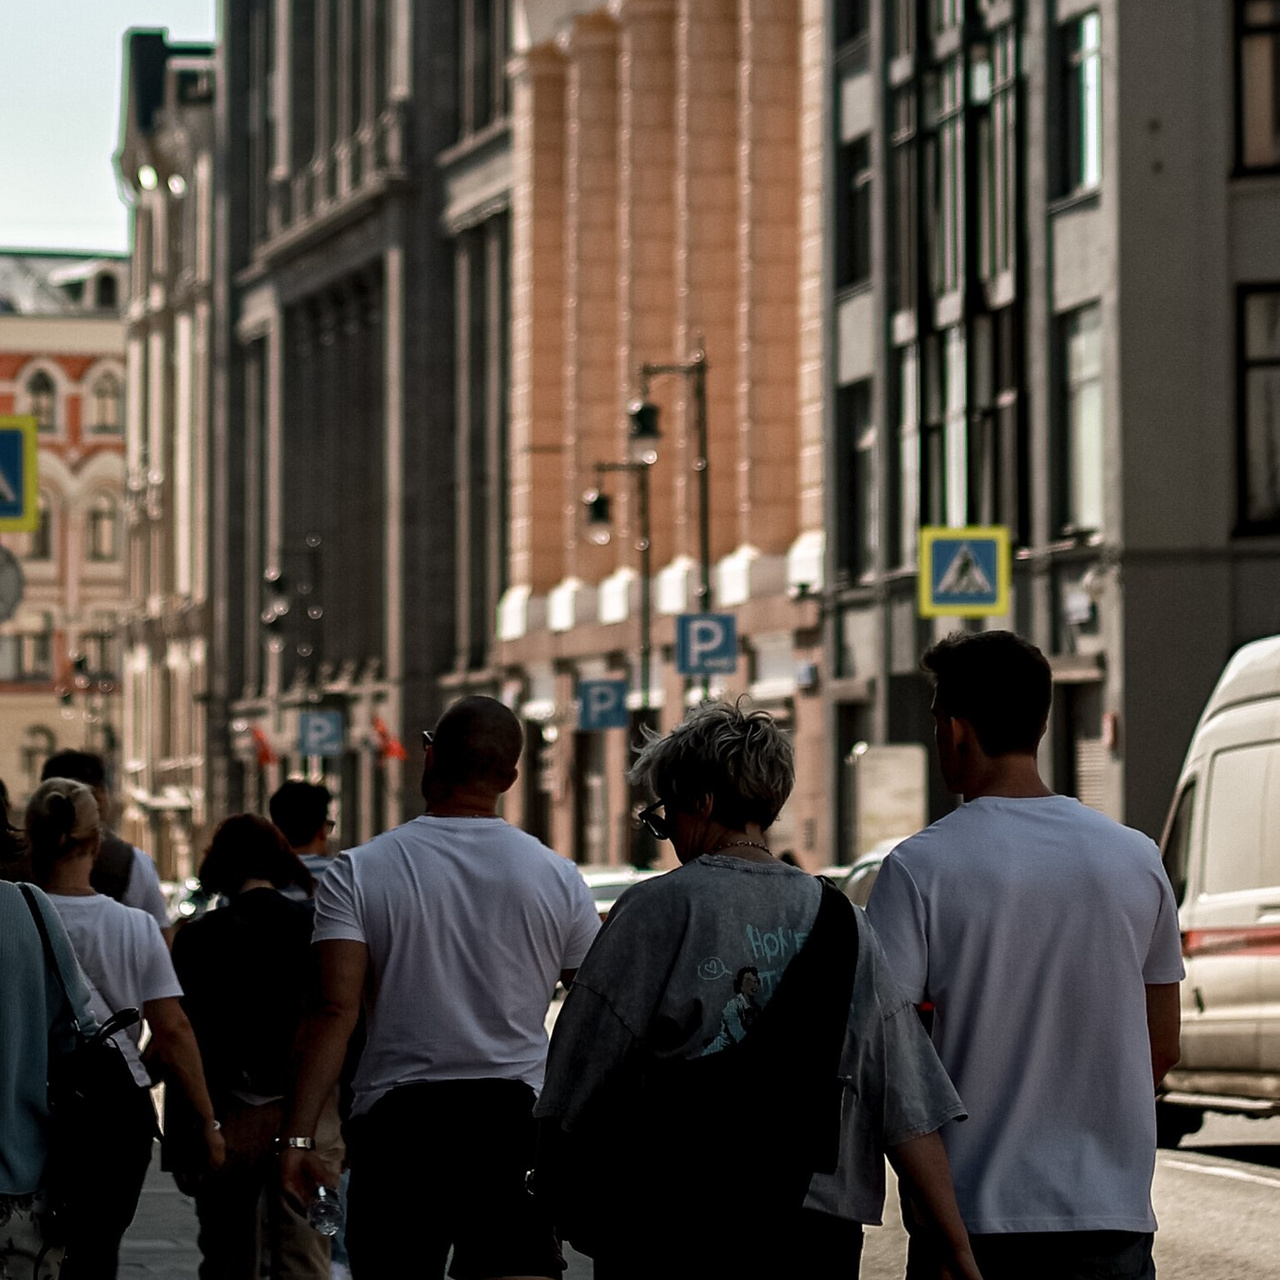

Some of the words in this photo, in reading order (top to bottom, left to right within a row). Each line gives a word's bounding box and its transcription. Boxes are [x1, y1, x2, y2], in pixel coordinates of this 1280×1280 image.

[690, 620, 723, 667] P
[590, 687, 616, 722] P
[309, 718, 331, 748] P
